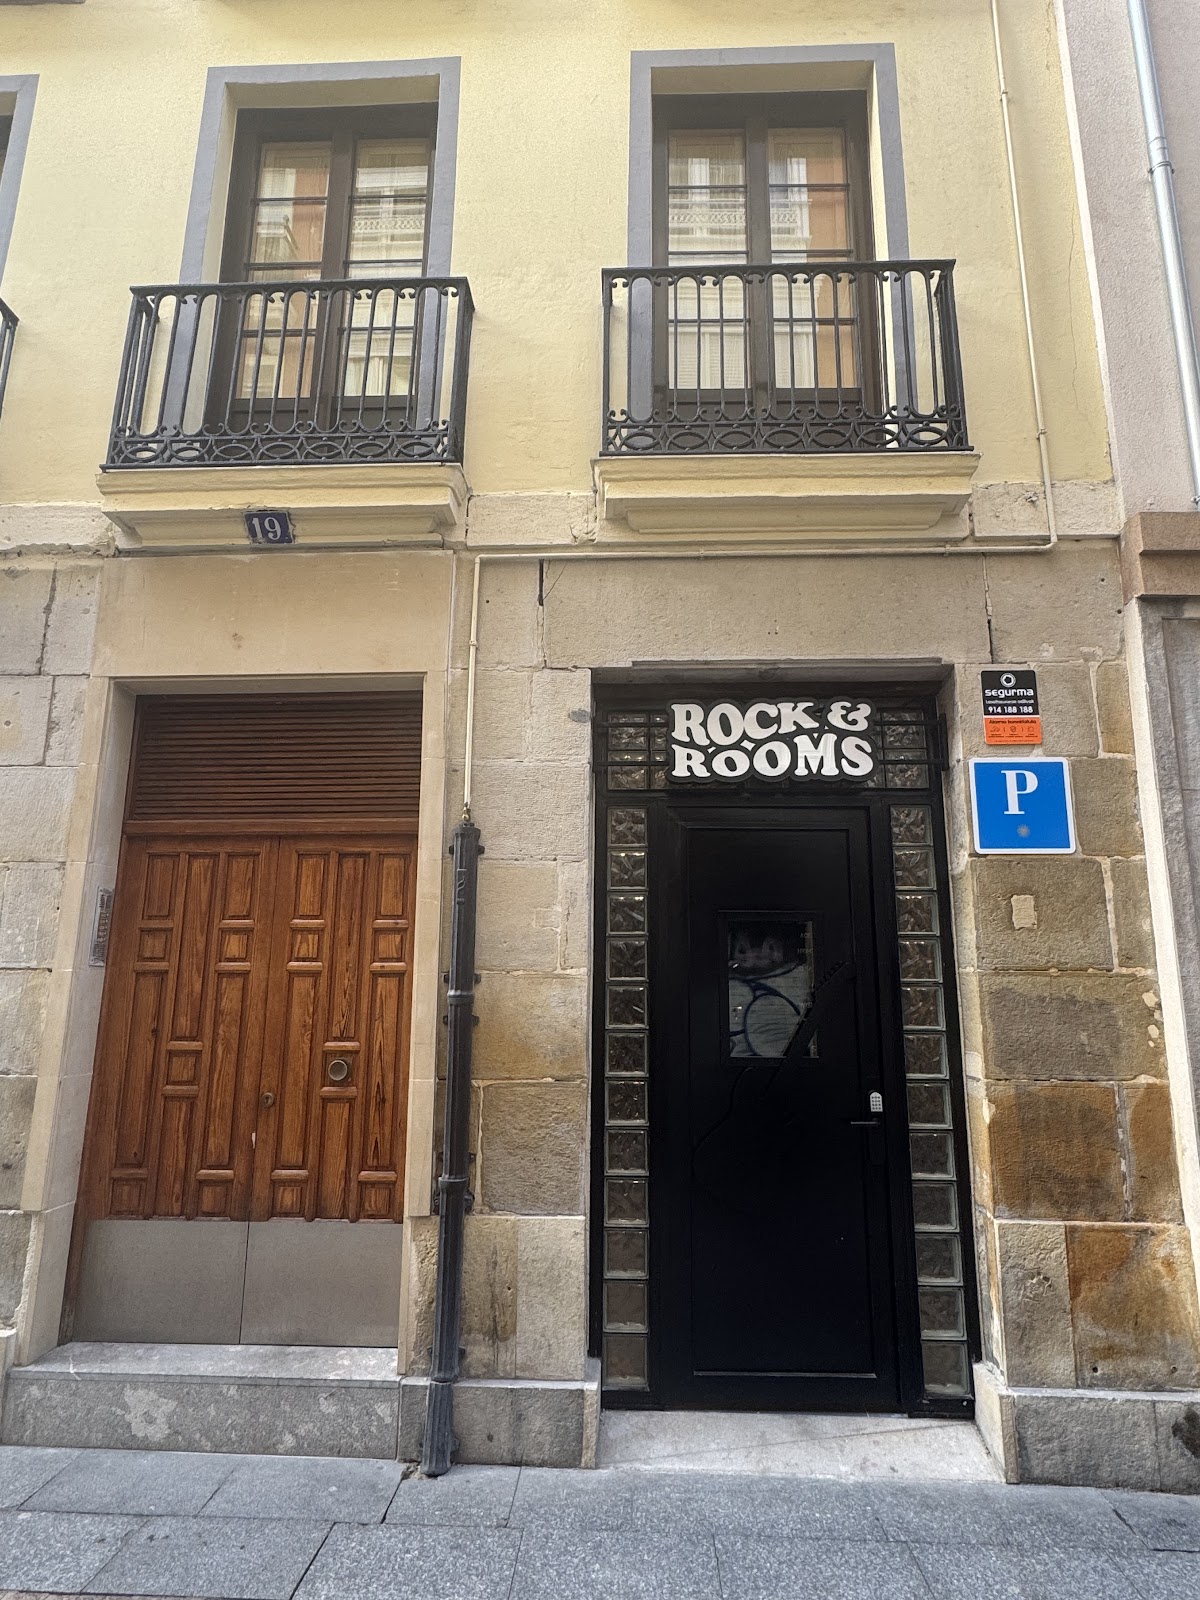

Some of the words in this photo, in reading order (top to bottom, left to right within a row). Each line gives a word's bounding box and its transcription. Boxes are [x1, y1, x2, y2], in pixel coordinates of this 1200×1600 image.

[251, 516, 282, 542] 19
[985, 688, 1034, 698] segurma
[670, 702, 819, 746] ROCK
[827, 701, 871, 731] &
[671, 733, 874, 777] ROOMS
[1000, 769, 1038, 815] P
